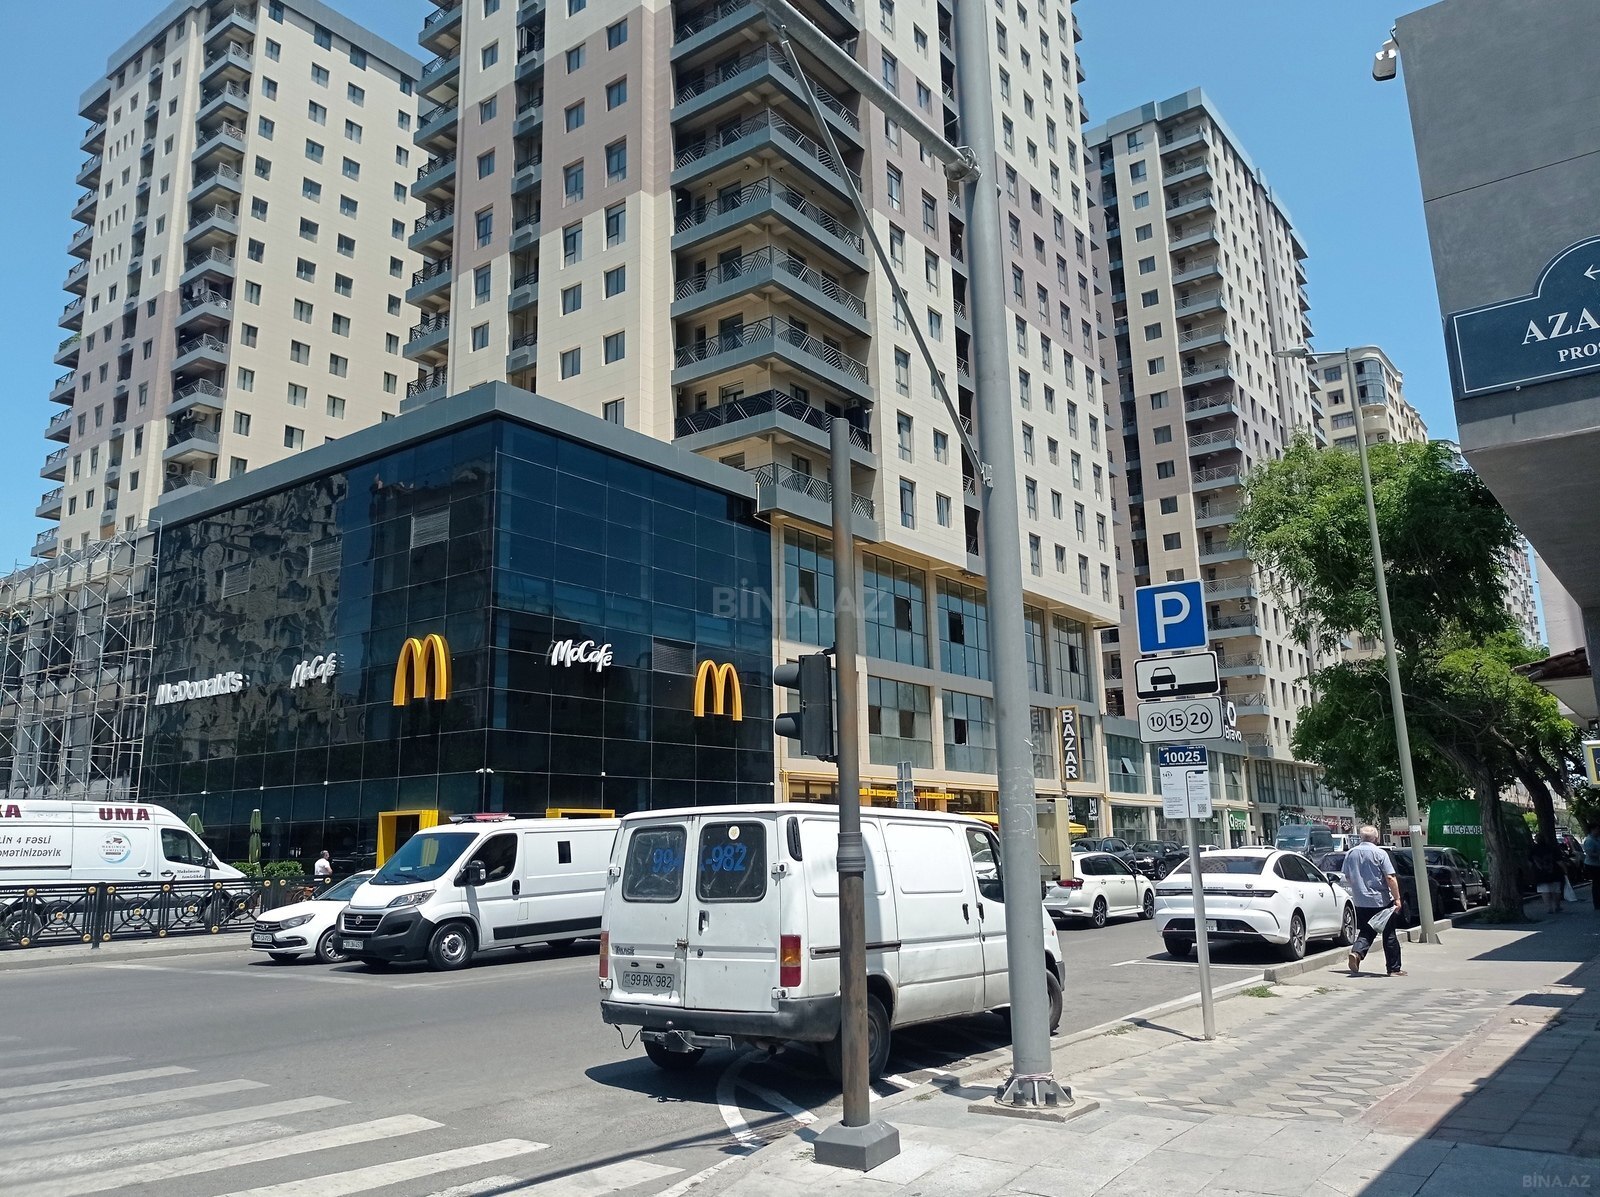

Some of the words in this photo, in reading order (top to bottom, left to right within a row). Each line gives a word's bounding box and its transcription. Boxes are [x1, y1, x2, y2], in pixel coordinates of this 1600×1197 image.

[1154, 591, 1190, 643] P
[155, 671, 244, 705] McDonald's
[1150, 716, 1163, 727] 10
[1169, 714, 1183, 727] 15
[1190, 712, 1209, 725] 20
[1062, 709, 1078, 779] BAZAR
[1164, 751, 1200, 763] 10025
[98, 807, 150, 820] UMA
[16, 836, 22, 844] 4
